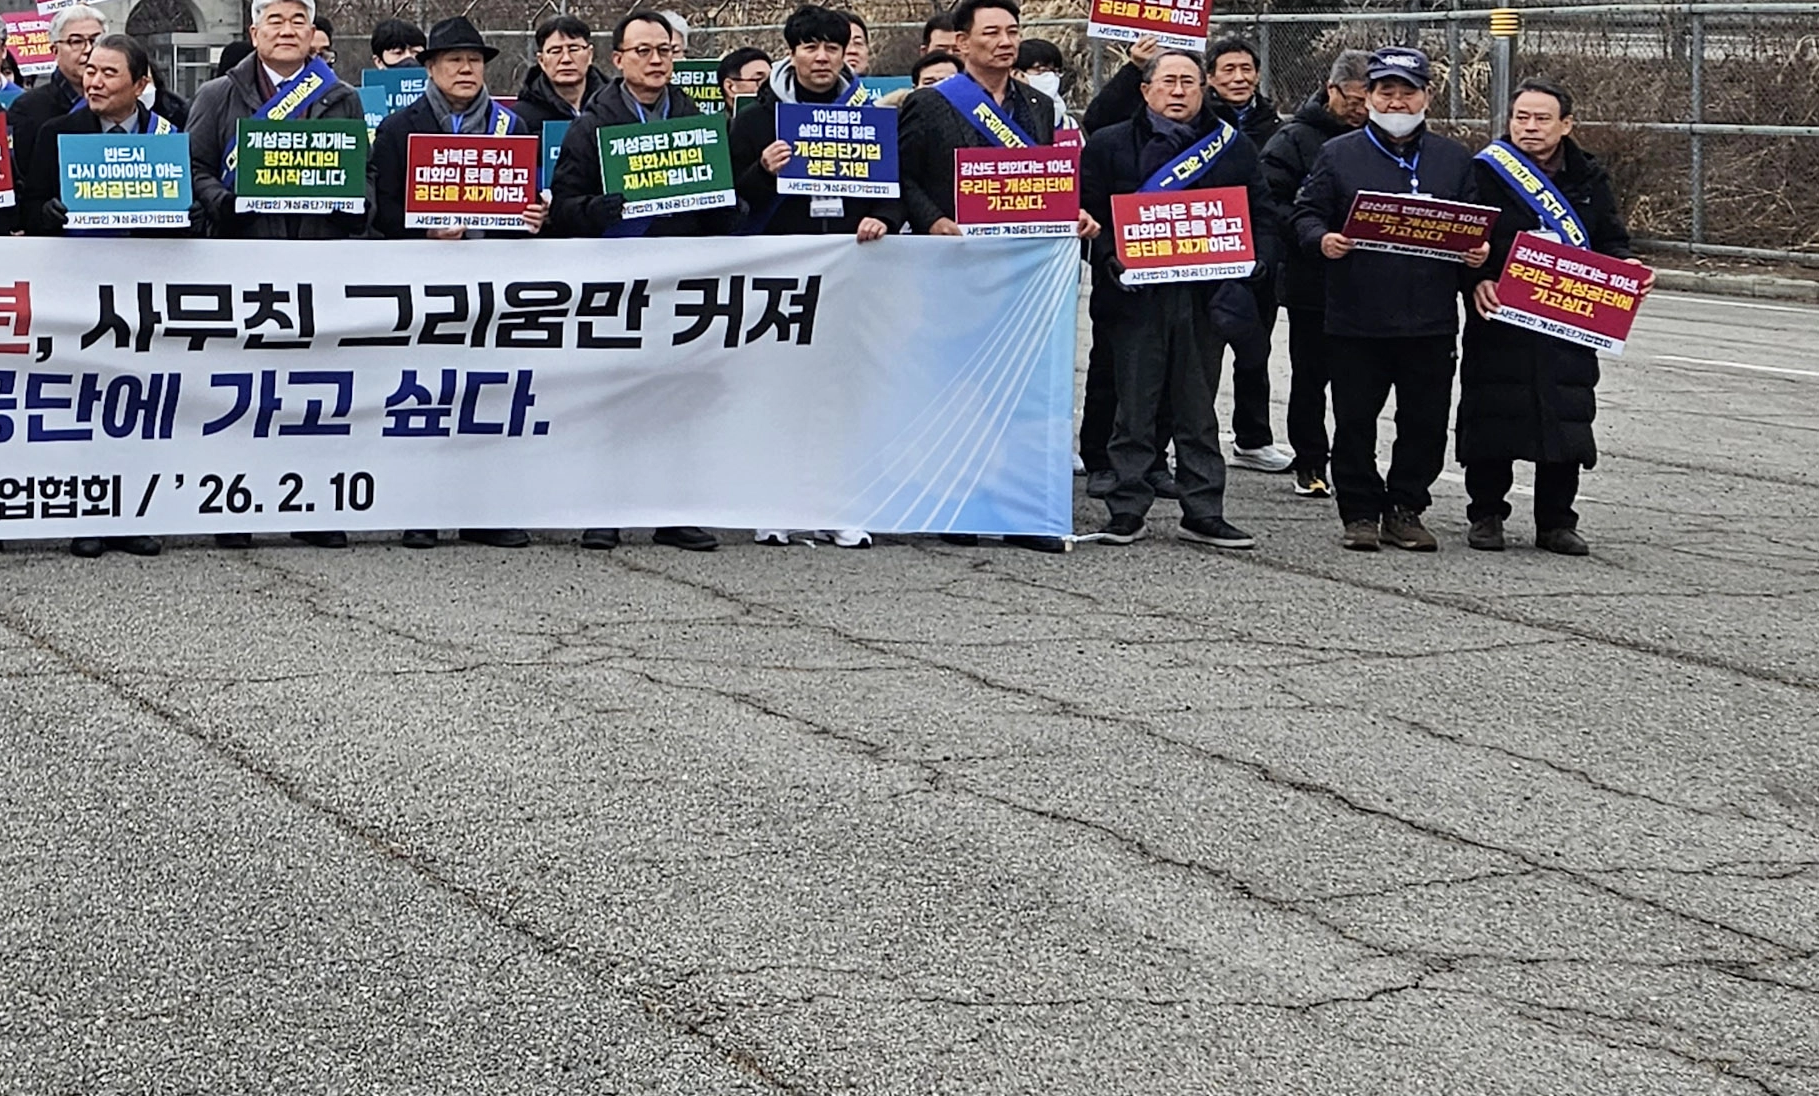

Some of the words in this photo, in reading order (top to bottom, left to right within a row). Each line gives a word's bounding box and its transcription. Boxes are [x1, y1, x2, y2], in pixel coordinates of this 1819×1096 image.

[1099, 0, 1140, 18] 공단을
[1142, 5, 1201, 26] 재개하라.
[812, 109, 862, 124] 10년동안
[247, 131, 308, 149] 개성공단
[311, 132, 356, 150] 재개는
[798, 123, 823, 138] 삶의
[825, 125, 849, 139] 터전
[852, 126, 876, 140] 잃은
[609, 133, 669, 156] 개성공단
[672, 128, 718, 147] 재개는
[793, 141, 882, 160] 개성공단기업
[104, 147, 145, 162] 반드시
[264, 150, 339, 167] 평화시대의
[433, 148, 478, 165] 남북은
[482, 149, 512, 166] 즉시
[628, 147, 703, 171] 평화시대의
[68, 164, 95, 179] 다시
[98, 163, 152, 178] 이어야만
[155, 163, 183, 178] 하는
[415, 166, 460, 183] 대화의
[464, 167, 494, 184] 문을
[498, 168, 528, 184] 열고
[623, 164, 713, 190] 재시작입니다
[807, 160, 836, 176] 생존
[839, 162, 869, 178] 지원
[961, 162, 996, 176] 강산도
[997, 160, 1044, 175] 변한다는
[1046, 159, 1075, 174] 10년,
[255, 169, 347, 186] 재시작입니다
[960, 179, 1001, 194] 우리는
[1004, 177, 1074, 193] 개성공단에
[74, 181, 158, 199] 개성공단의
[162, 180, 179, 198] 길
[414, 185, 459, 201] 공단을
[463, 185, 528, 202] 재개하라.
[987, 194, 1047, 211] 가고싶다.
[1139, 203, 1187, 222] 남북은
[1190, 200, 1223, 217] 즉시
[1535, 190, 1567, 220] 가고
[1359, 200, 1399, 213] 강산도
[1401, 205, 1455, 221] 변한다는
[1458, 213, 1488, 226] 10년,
[1123, 222, 1172, 240] 대화의
[1175, 220, 1207, 237] 문을
[1210, 217, 1243, 235] 열고
[1353, 211, 1400, 225] 우리는
[1403, 216, 1484, 236] 개성공단에
[1379, 225, 1446, 242] 가고싶다.
[1125, 239, 1173, 257] 공단을
[1176, 235, 1246, 254] 재개하라.
[1515, 245, 1555, 268] 강산도
[1556, 257, 1608, 284] 변한다는
[1609, 273, 1641, 295] 10년,
[1507, 262, 1554, 288] 우리는
[1555, 275, 1634, 312] 개성공단에
[1530, 286, 1595, 319] 가고싶다.
[81, 283, 314, 352] 사무친
[338, 279, 650, 349] 그리움만
[672, 275, 821, 348] 커져
[203, 370, 353, 438] 가고
[382, 369, 549, 437] 싶다.
[279, 473, 314, 512] 2.
[330, 472, 374, 511] 10
